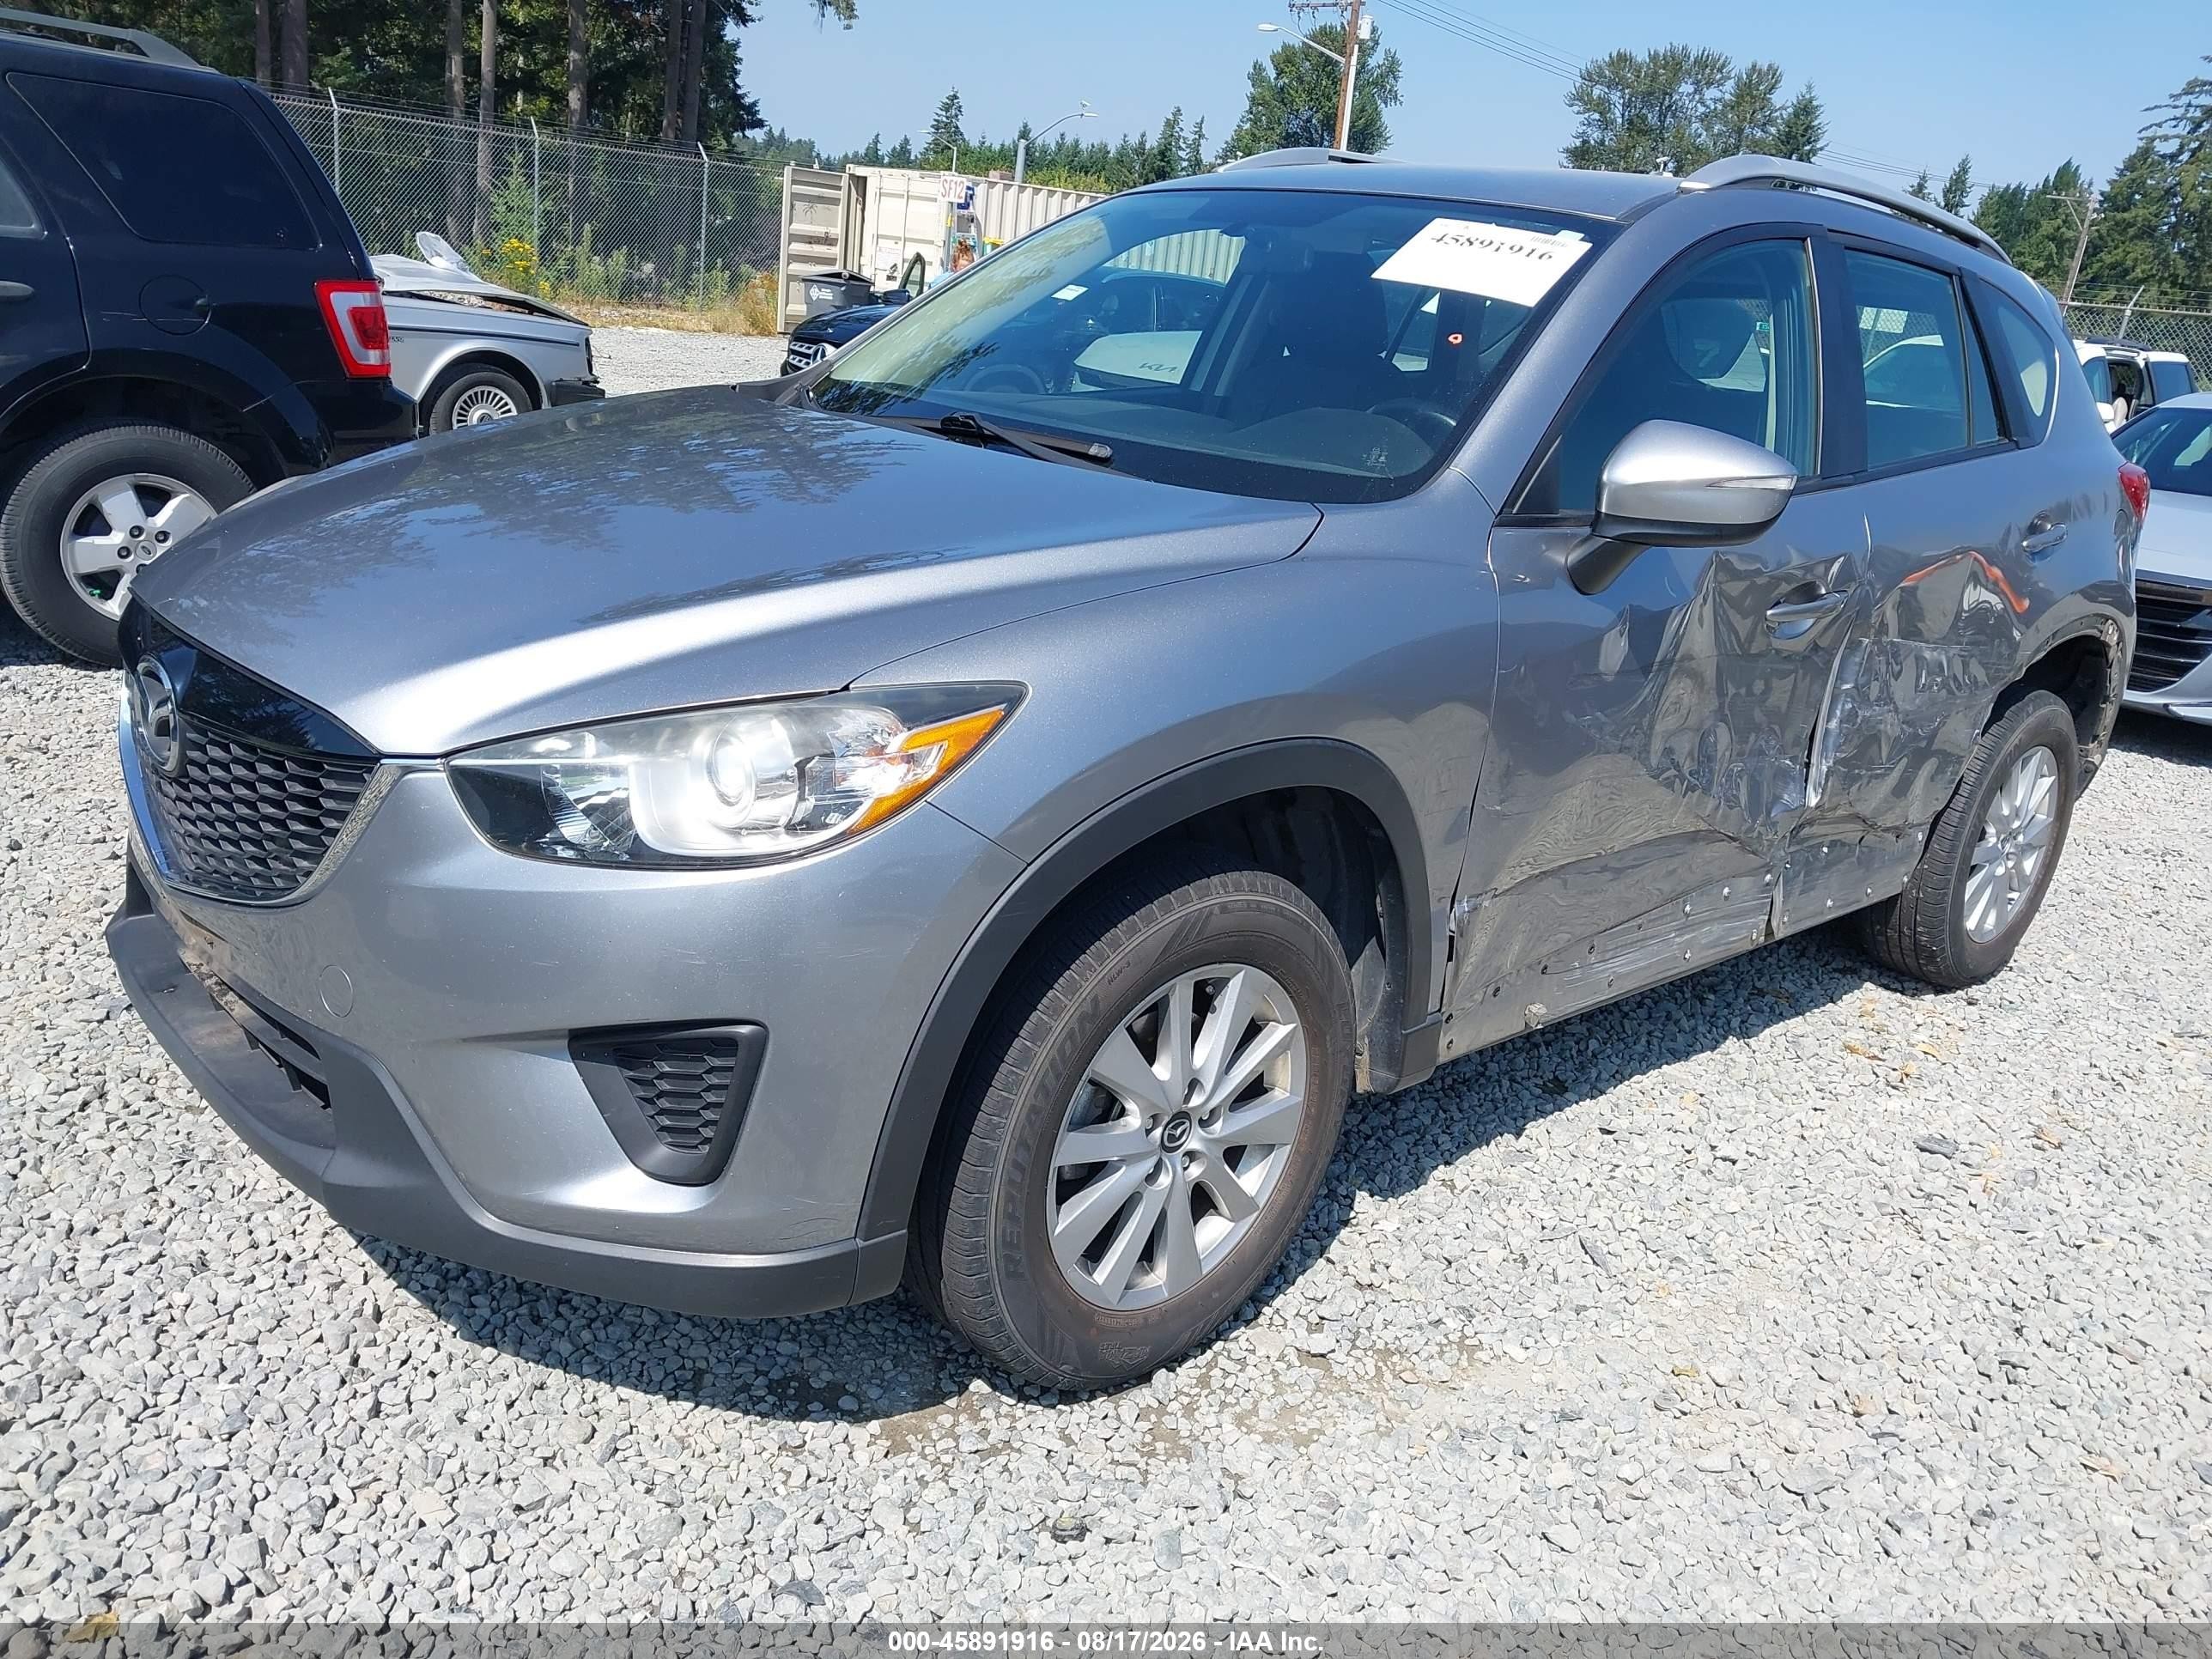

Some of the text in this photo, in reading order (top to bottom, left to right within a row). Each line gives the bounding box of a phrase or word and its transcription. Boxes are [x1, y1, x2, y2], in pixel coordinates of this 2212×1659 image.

[941, 179, 965, 199] SF12
[1431, 233, 1553, 260] 45891916
[1001, 993, 1101, 1281] REPUTATION
